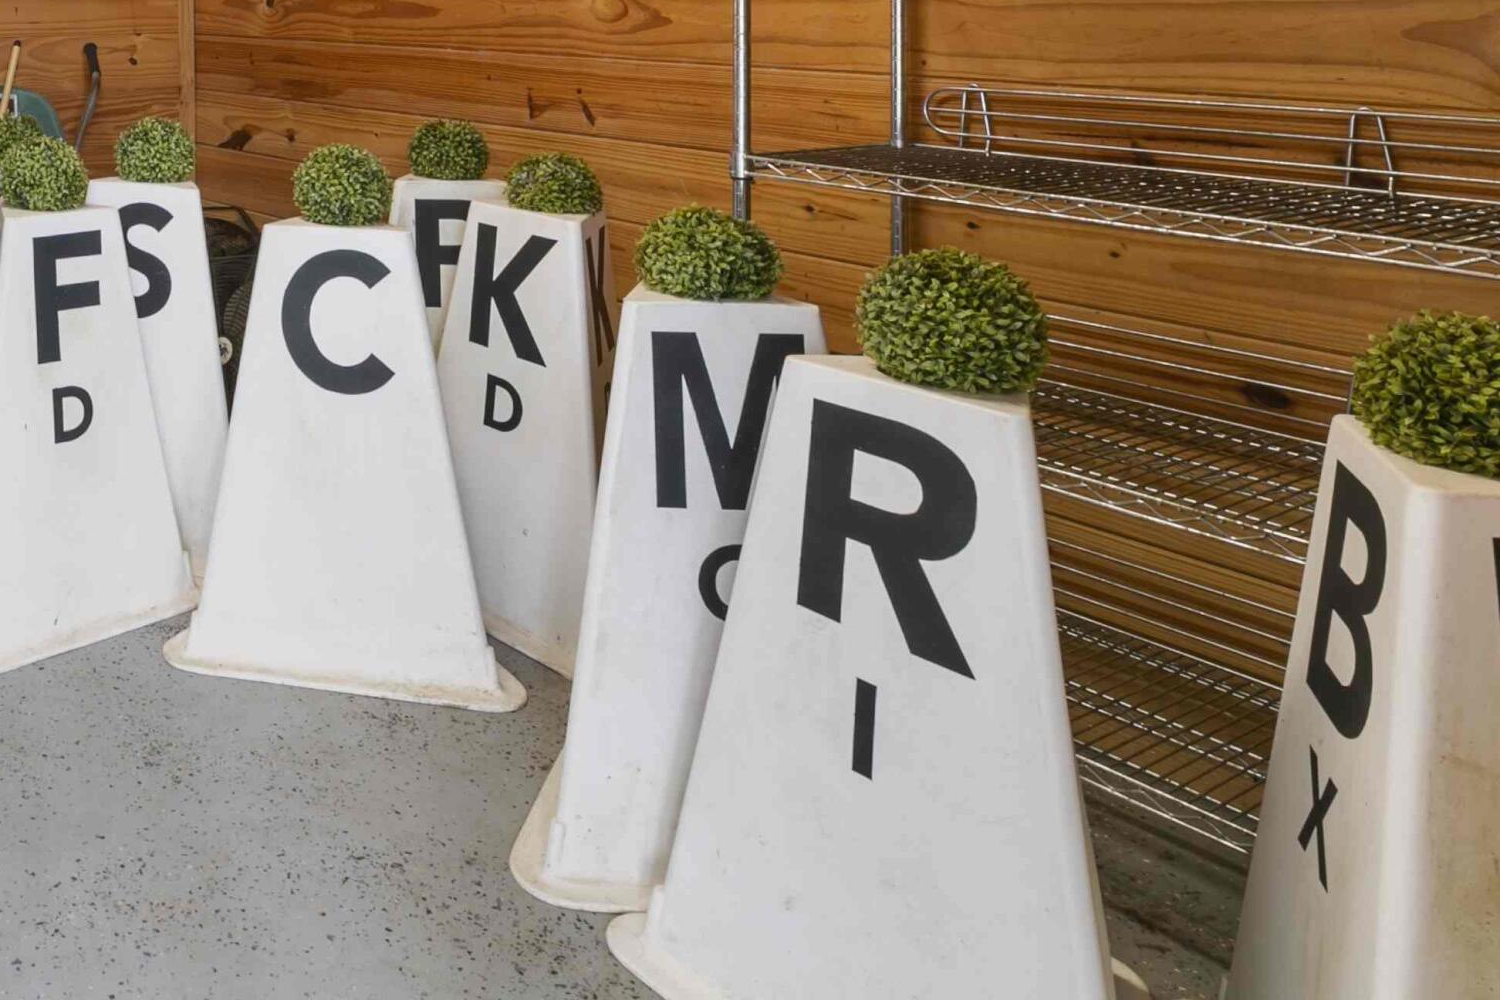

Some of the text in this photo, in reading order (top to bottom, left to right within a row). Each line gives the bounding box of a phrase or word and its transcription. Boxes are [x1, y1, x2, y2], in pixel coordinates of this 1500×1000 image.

[32, 229, 102, 365] F
[118, 202, 174, 319] S
[281, 249, 395, 395] C
[468, 222, 558, 368] K
[585, 225, 615, 367] K
[52, 385, 93, 444] D
[483, 373, 523, 432] D
[651, 331, 805, 511] M
[797, 398, 978, 681] R
[1306, 459, 1387, 740] B
[852, 677, 877, 781] I
[1297, 744, 1338, 893] X
